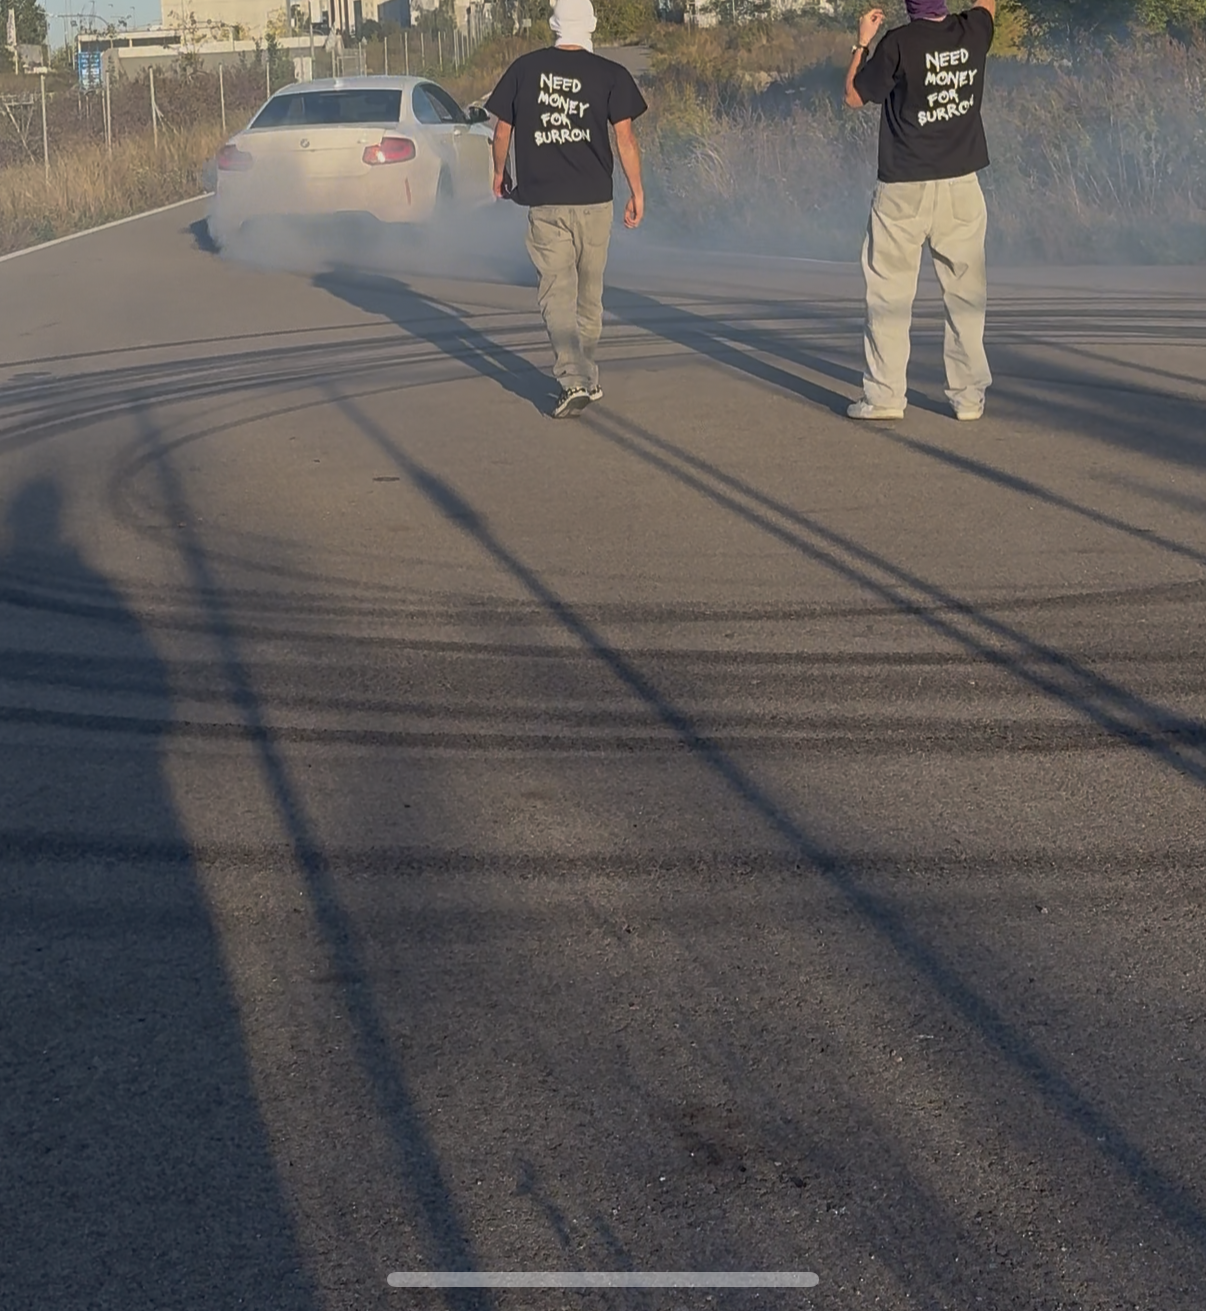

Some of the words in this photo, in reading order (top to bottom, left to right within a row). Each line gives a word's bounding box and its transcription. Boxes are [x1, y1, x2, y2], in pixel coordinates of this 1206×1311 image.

[925, 48, 969, 72] NEED
[540, 73, 582, 94] NEED
[924, 69, 977, 90] MONEY
[537, 90, 590, 118] MONEY
[926, 89, 959, 107] FOR
